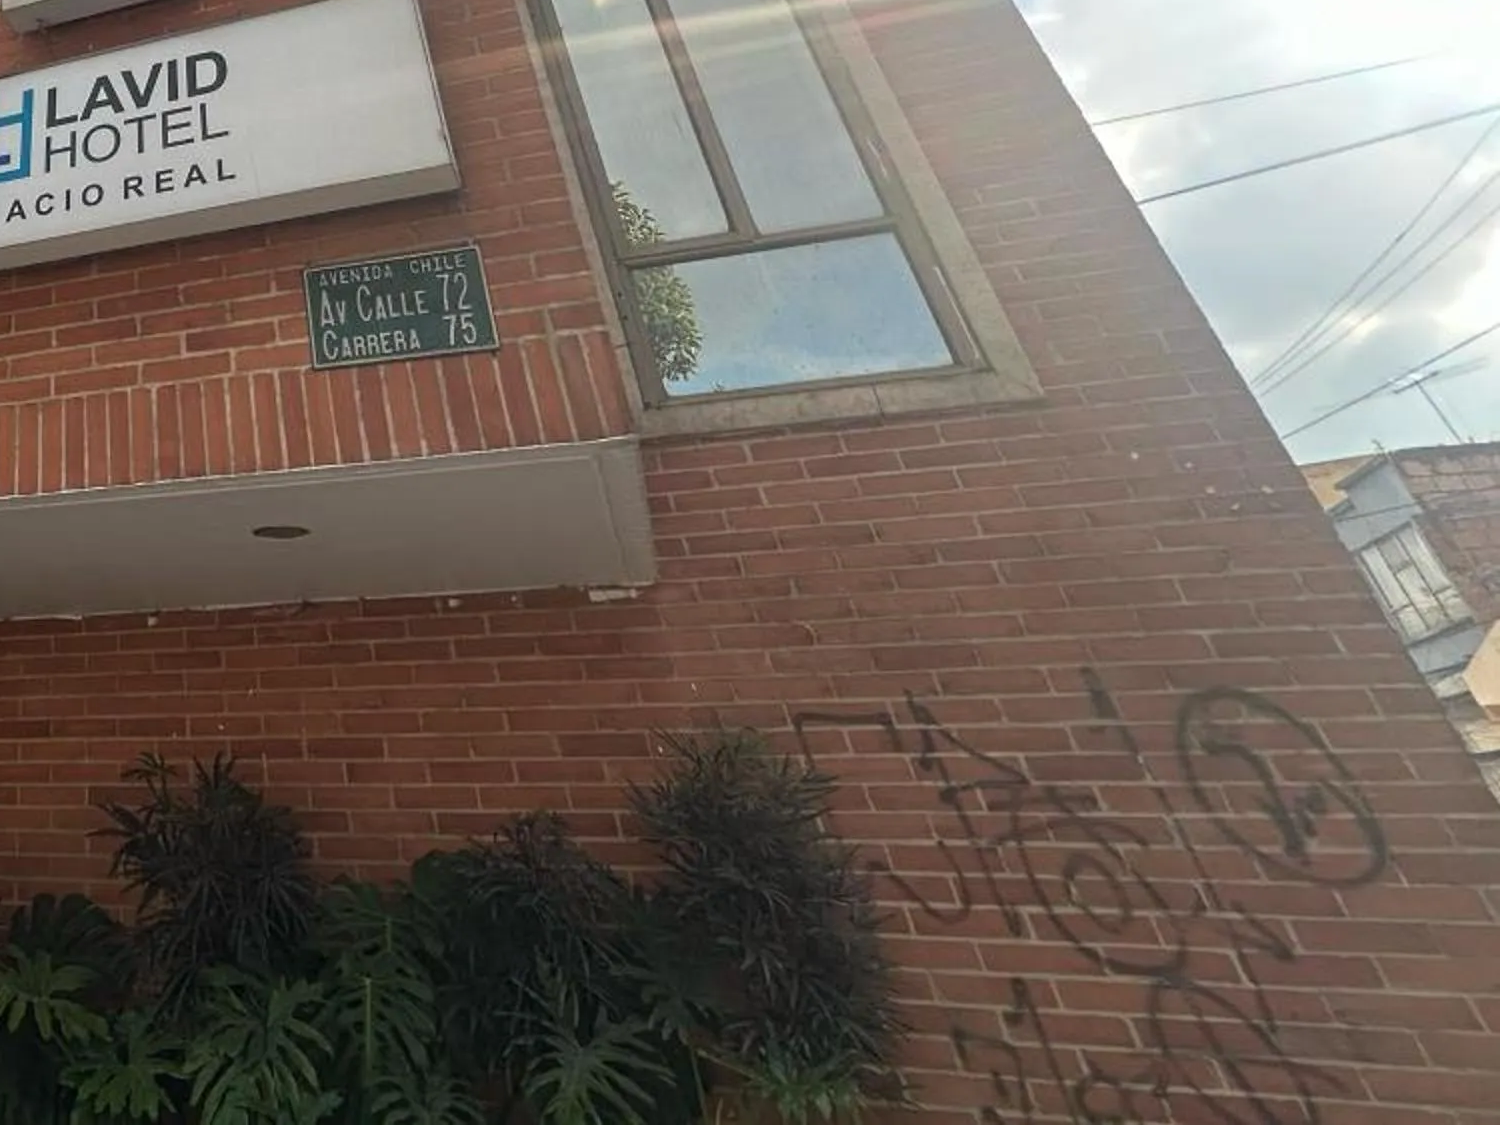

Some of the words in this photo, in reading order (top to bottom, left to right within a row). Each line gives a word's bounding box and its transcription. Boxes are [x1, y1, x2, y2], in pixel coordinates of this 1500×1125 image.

[46, 50, 230, 128] LAVID
[45, 103, 230, 173] HOTEL
[123, 158, 237, 200] REAL
[319, 264, 393, 287] AVENIDA
[409, 253, 467, 274] CHILE
[436, 273, 473, 312] 72
[442, 313, 478, 346] 75
